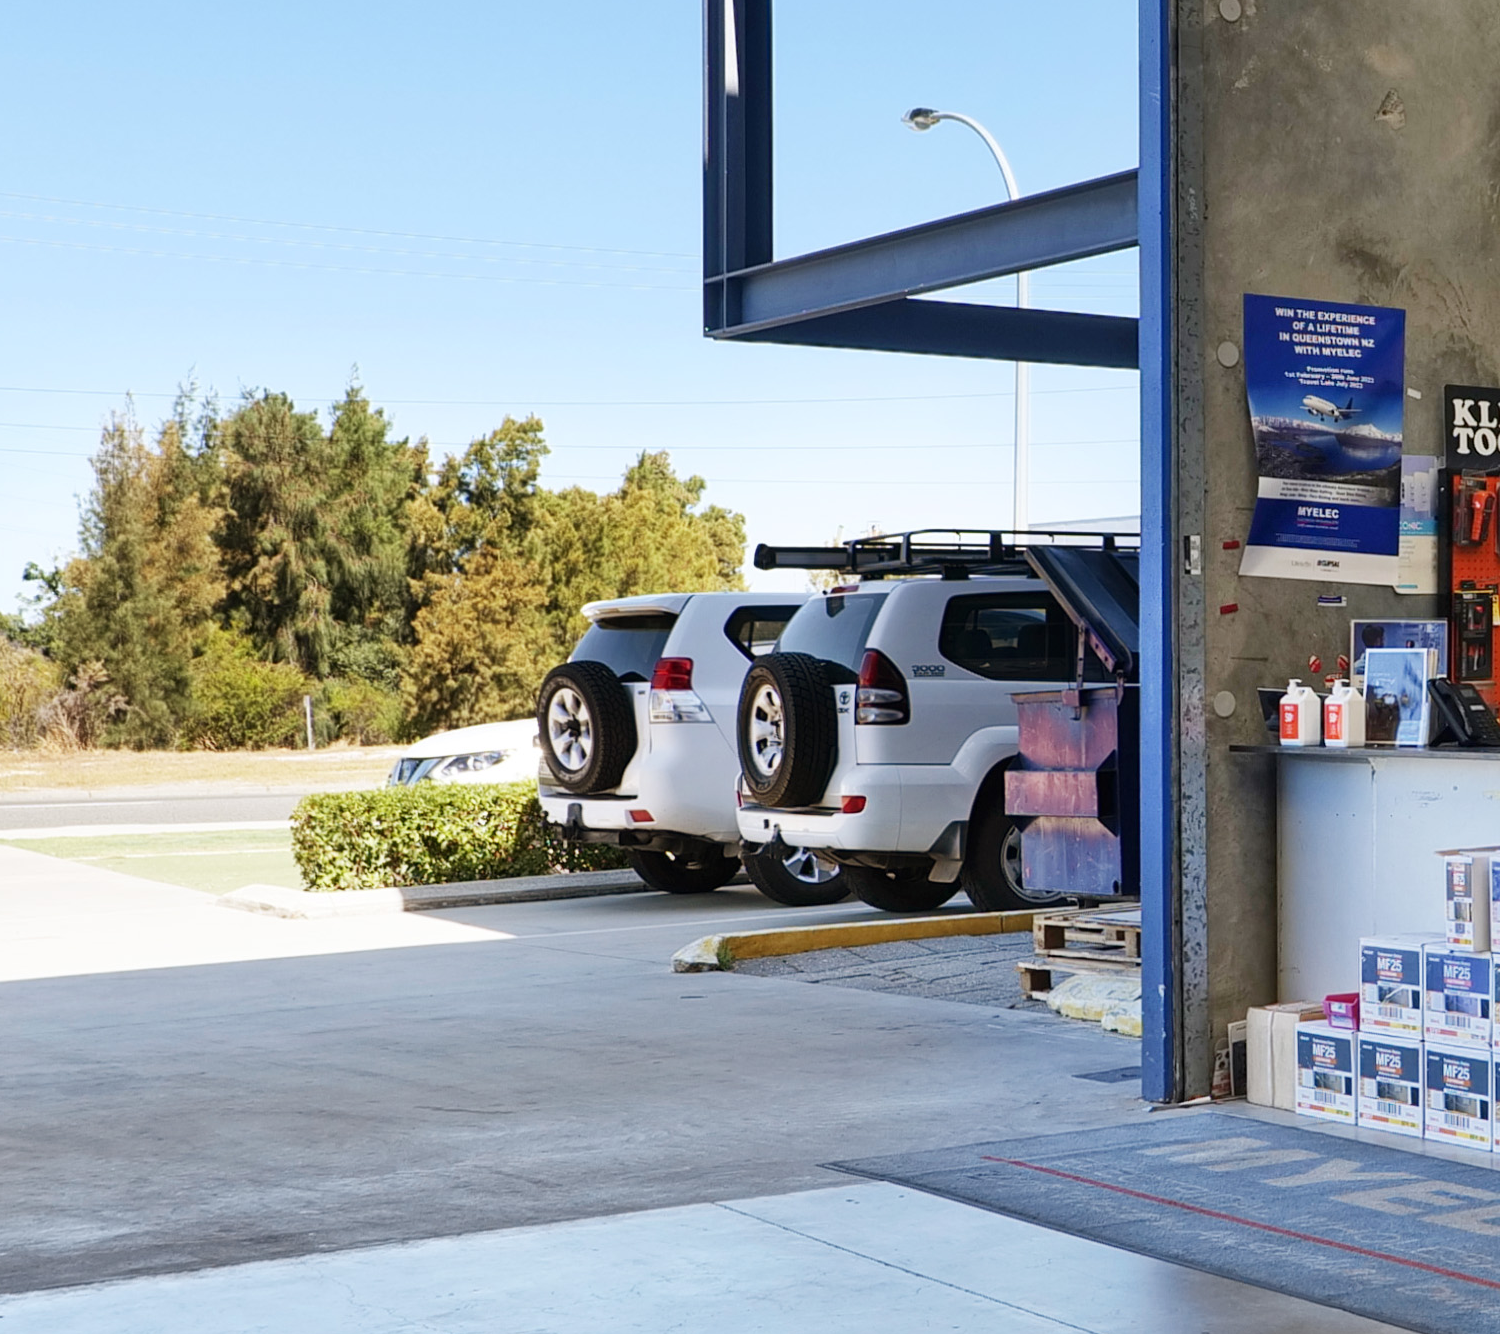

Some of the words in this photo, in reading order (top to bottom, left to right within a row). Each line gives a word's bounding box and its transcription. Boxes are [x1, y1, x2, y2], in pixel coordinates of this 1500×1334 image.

[1275, 307, 1294, 317] WIN
[1296, 309, 1316, 319] THE
[1317, 312, 1376, 325] EXPERIENCE
[1292, 321, 1305, 330] OF
[1308, 323, 1315, 331] A
[1317, 323, 1360, 335] LIFETIME
[1279, 332, 1290, 341] IN
[1292, 334, 1359, 346] QUEENSTOWN
[1361, 339, 1375, 347] NZ
[1294, 346, 1320, 355] WITH
[1322, 347, 1362, 358] MYELEC
[1297, 506, 1340, 518] MYELEC
[1377, 956, 1402, 973] MF25
[1444, 964, 1471, 980] MF25
[1312, 1043, 1336, 1058] MF25
[1376, 1052, 1401, 1069] MF25
[1443, 1063, 1470, 1081] MF25
